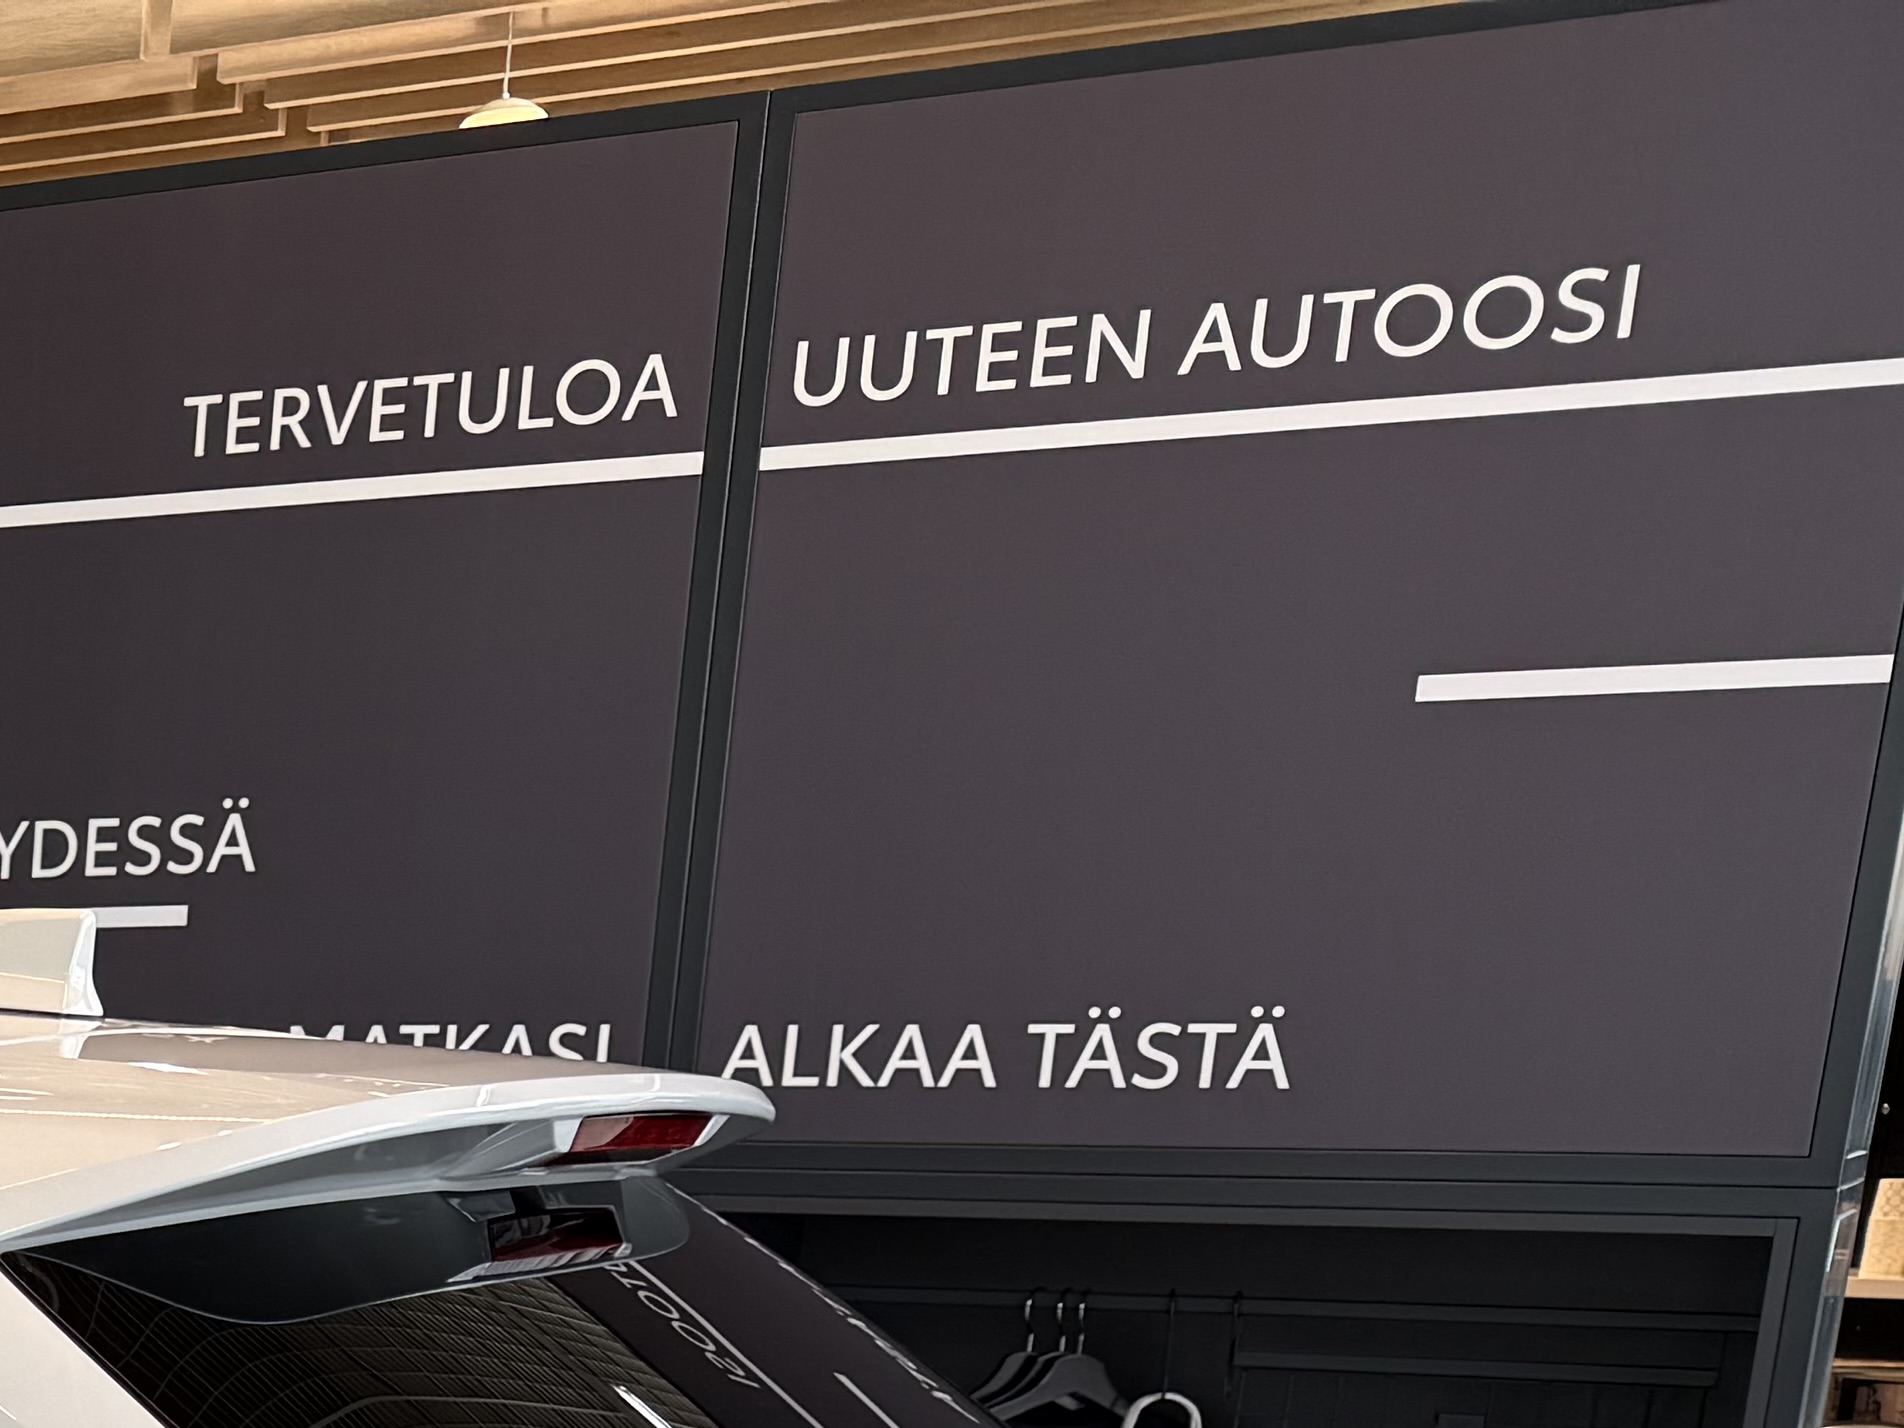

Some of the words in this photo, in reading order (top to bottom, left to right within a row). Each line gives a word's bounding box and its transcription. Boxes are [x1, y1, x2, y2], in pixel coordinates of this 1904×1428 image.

[185, 353, 677, 458] TERVETULOA
[791, 308, 1151, 408] UUTEEN
[1180, 263, 1641, 376] AUTOOSI
[290, 1023, 610, 1062] TASI
[721, 1024, 996, 1087] ALKAA
[1027, 1005, 1290, 1089] TÄSTÄ
